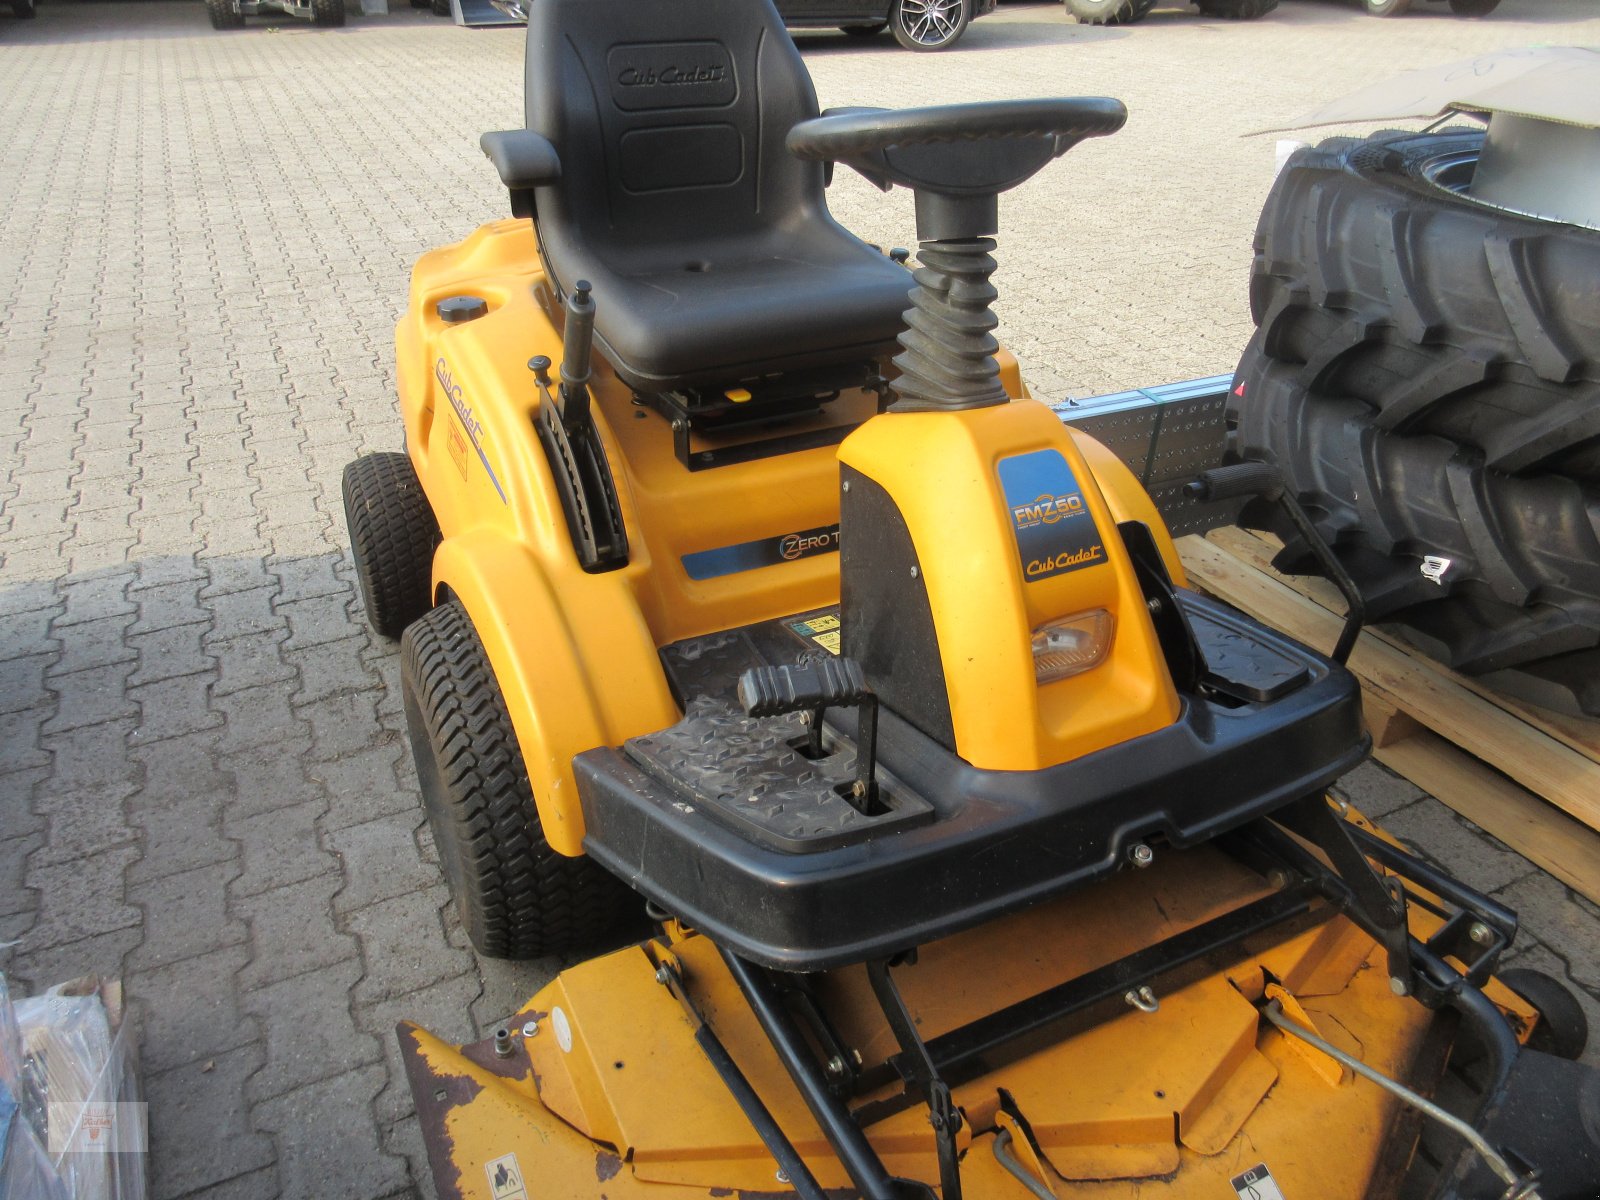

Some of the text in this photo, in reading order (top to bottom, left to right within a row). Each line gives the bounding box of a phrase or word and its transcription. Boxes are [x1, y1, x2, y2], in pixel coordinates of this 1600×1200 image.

[618, 65, 724, 87] Cub Cadet
[435, 357, 452, 393] Cub
[451, 384, 484, 447] Cadet
[1014, 496, 1082, 523] FMZ50
[784, 534, 830, 555] ZERO
[1026, 545, 1101, 576] Cub Cadet
